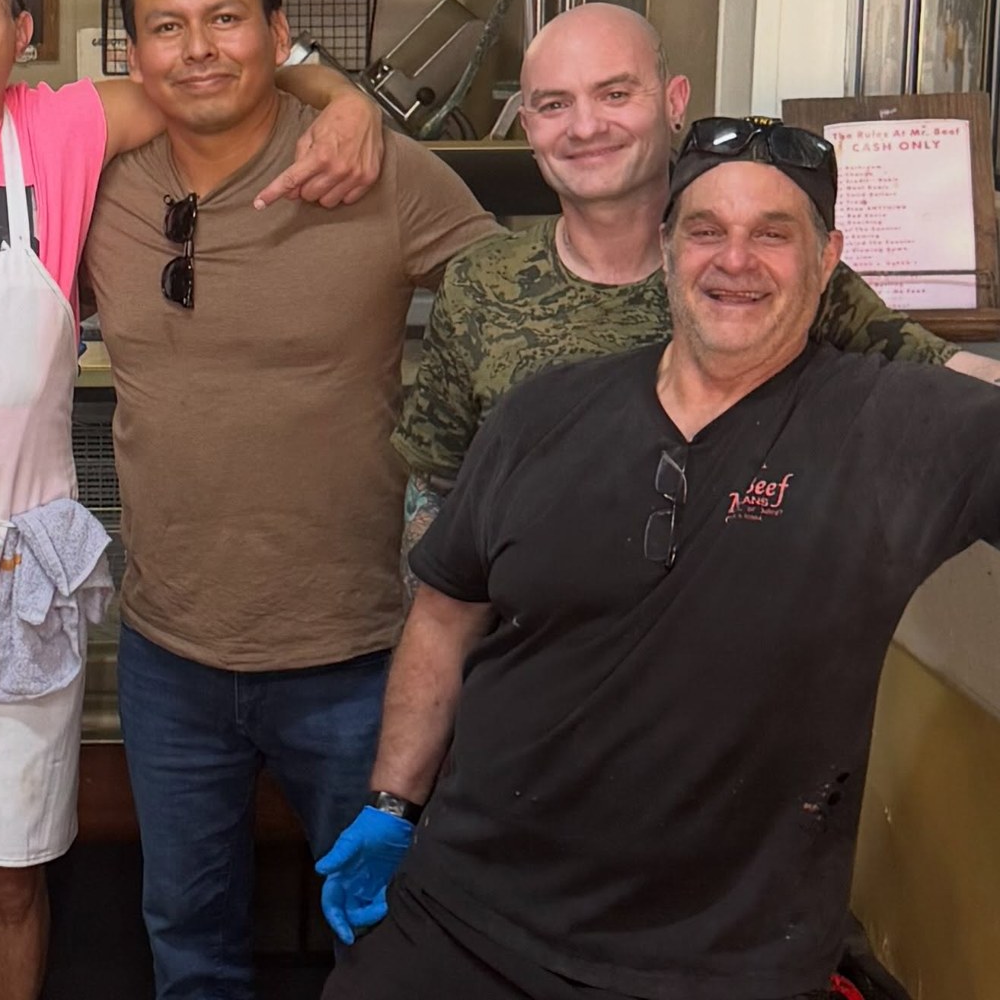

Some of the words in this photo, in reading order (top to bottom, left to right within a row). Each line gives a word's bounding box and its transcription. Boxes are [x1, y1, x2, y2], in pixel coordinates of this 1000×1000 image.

[832, 132, 852, 141] The
[856, 130, 889, 139] Rules
[892, 129, 906, 138] At
[909, 127, 930, 137] Mr.
[934, 128, 961, 136] Beef
[852, 143, 893, 152] CASH
[898, 140, 941, 150] ONLY
